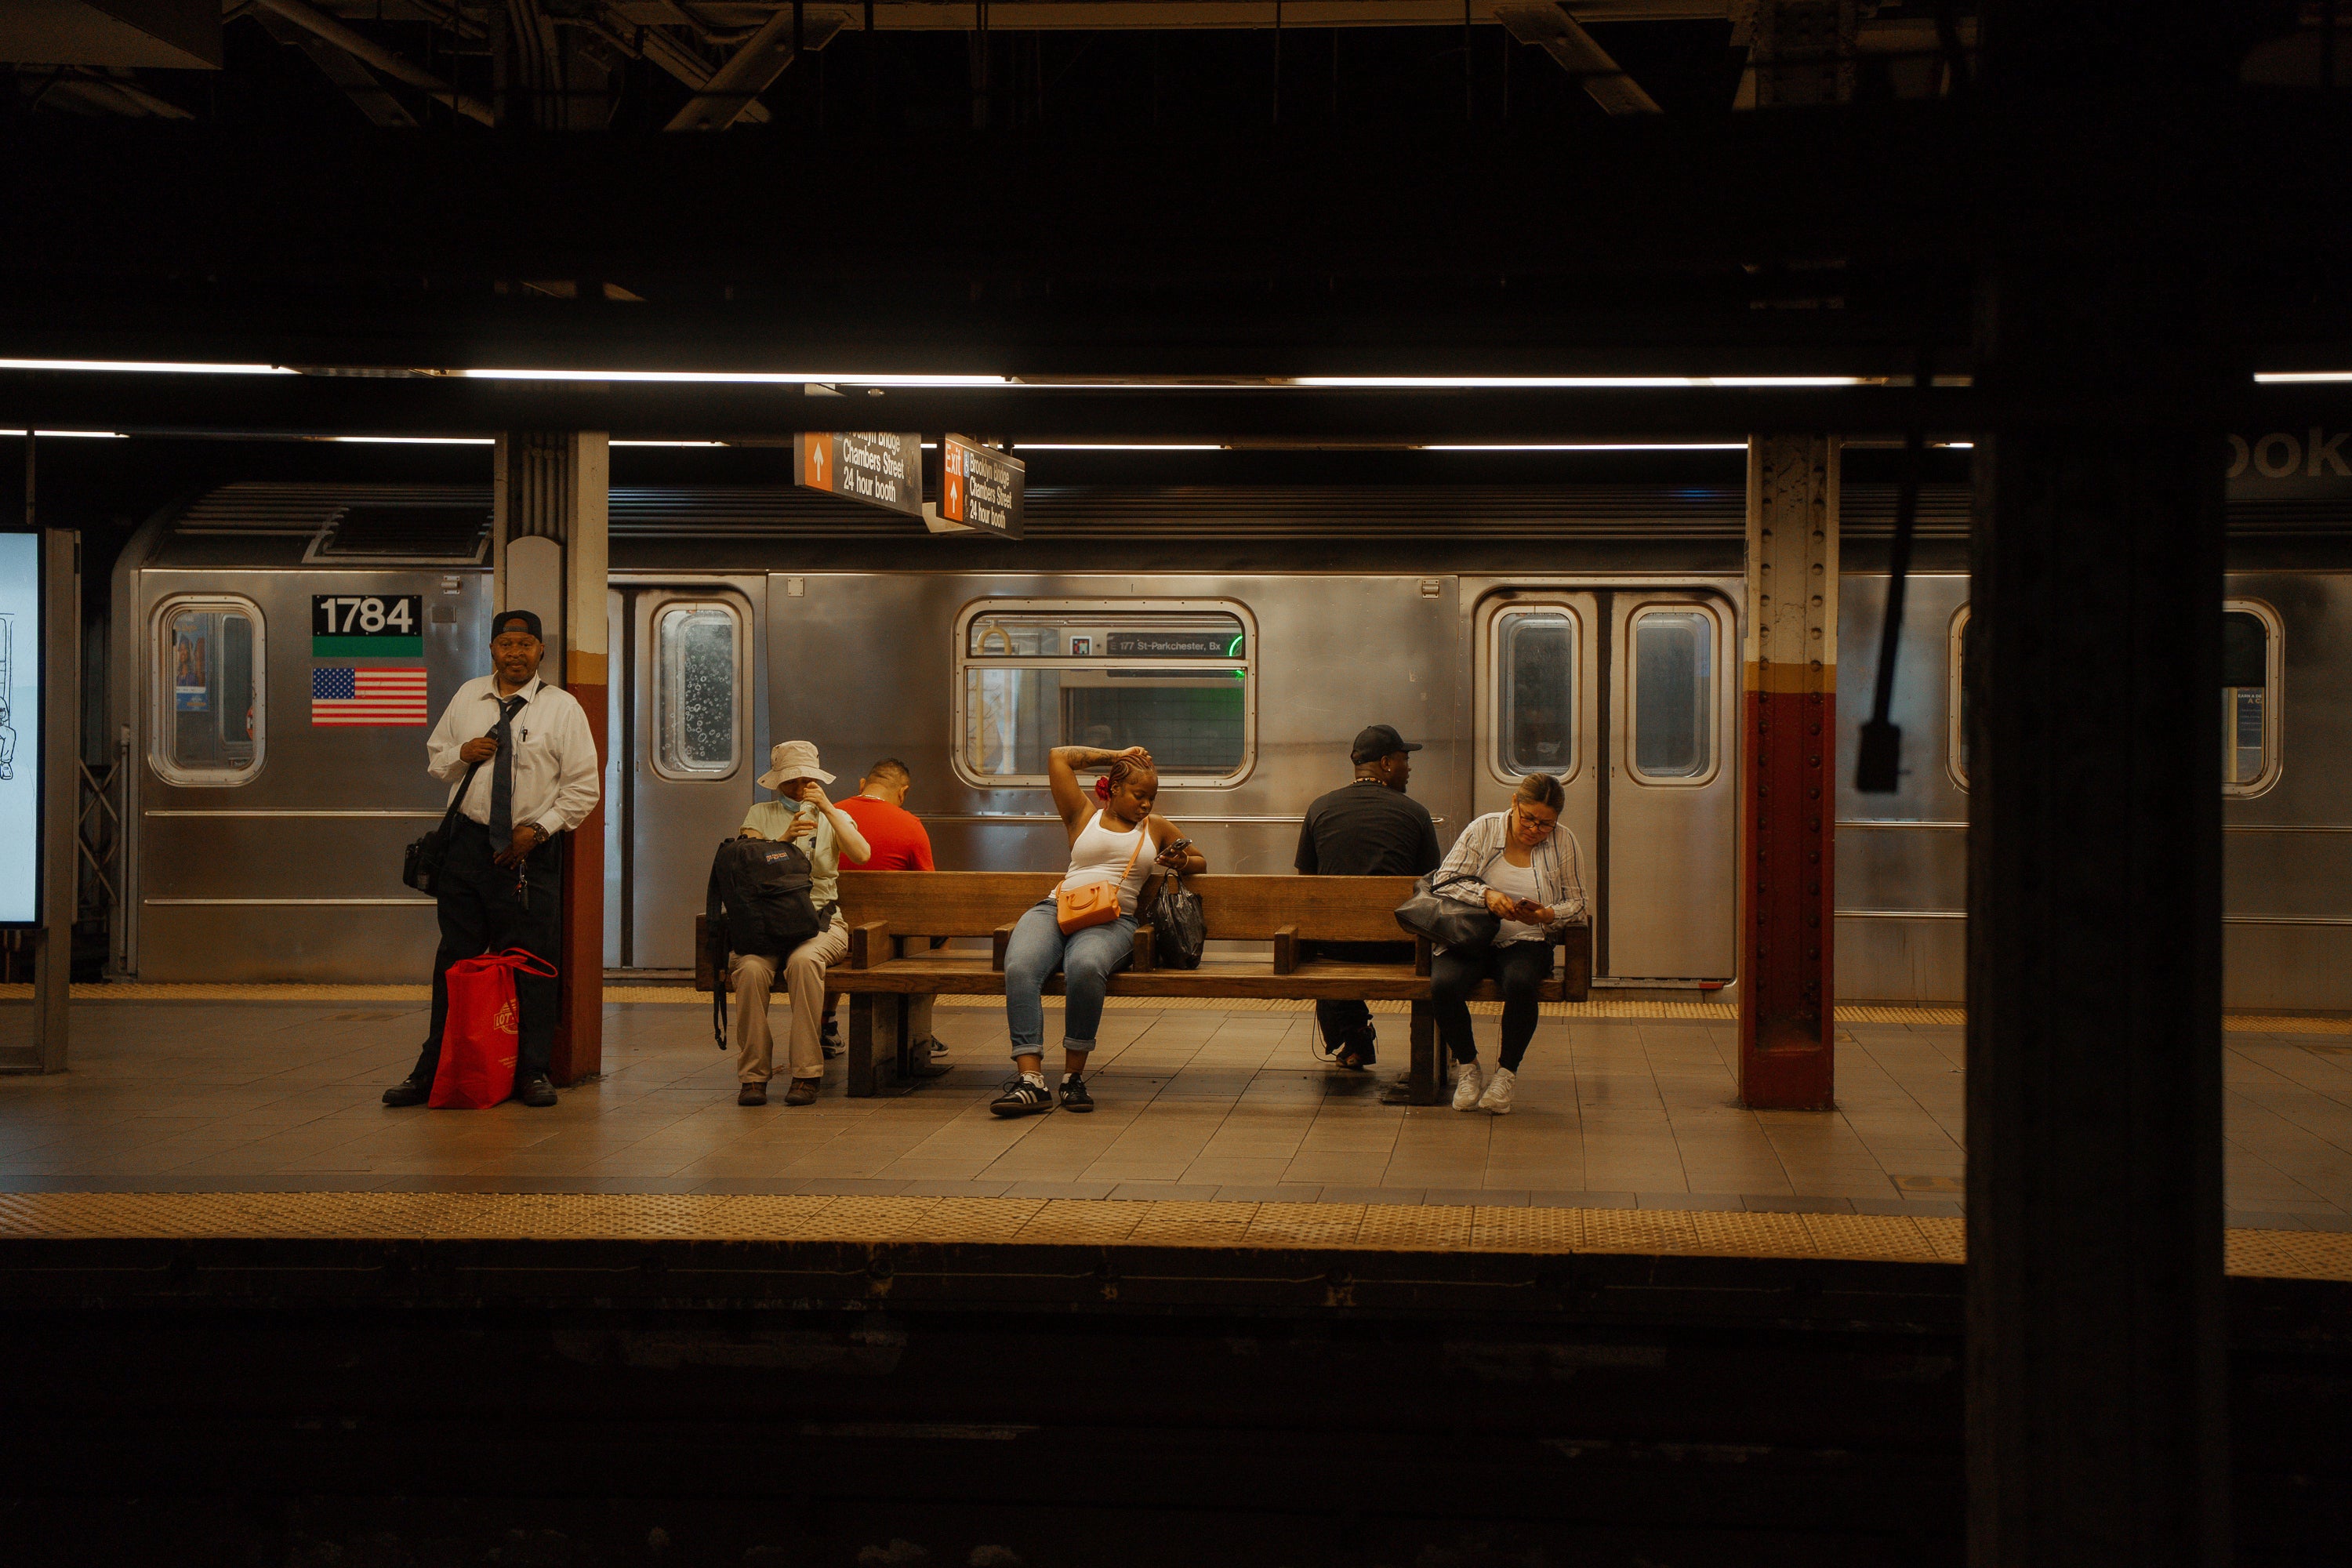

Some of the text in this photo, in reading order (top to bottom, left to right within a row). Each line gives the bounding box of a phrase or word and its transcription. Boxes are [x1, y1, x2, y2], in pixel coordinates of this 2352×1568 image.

[843, 437, 880, 472] Chambers
[883, 451, 904, 479] Street
[946, 443, 961, 477] Exit
[970, 452, 1010, 489] Brooklyn Bridge
[844, 466, 896, 502] 24 hour booth
[969, 476, 1012, 510] Chambers Street
[970, 499, 1006, 529] 24 hour booth
[321, 597, 413, 633] 1784
[1137, 641, 1207, 651] St-Parkchester,
